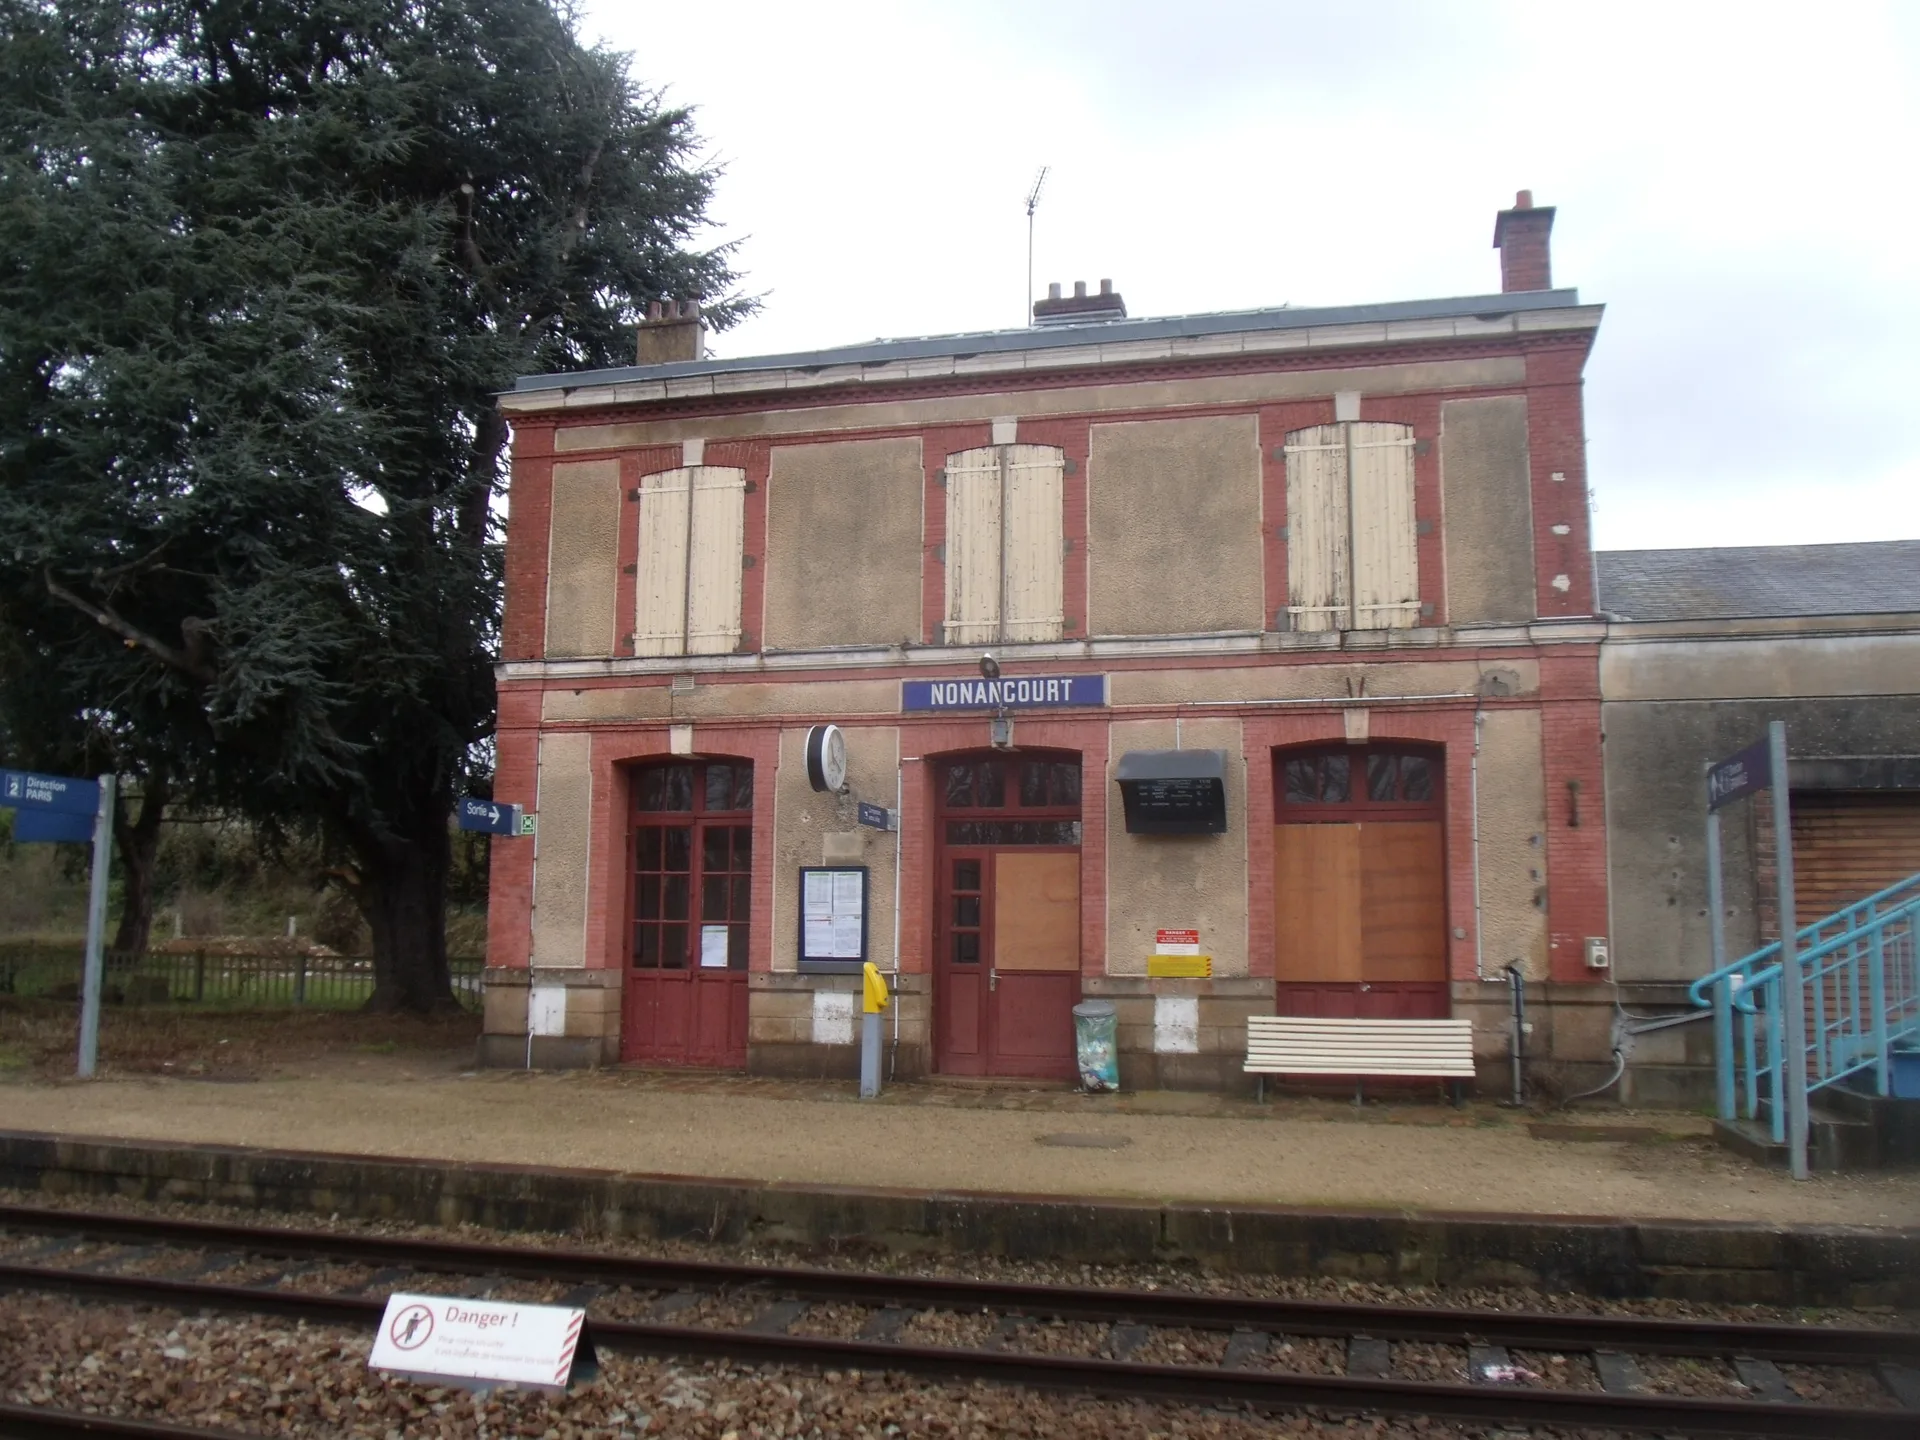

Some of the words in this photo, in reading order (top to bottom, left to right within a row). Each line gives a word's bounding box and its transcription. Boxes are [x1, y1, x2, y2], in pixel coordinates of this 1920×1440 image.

[931, 679, 1073, 705] NONANCOURT
[10, 782, 18, 796] 2
[27, 776, 66, 793] Direction
[26, 788, 53, 802] PARIS
[467, 802, 487, 816] Sortie
[445, 1306, 508, 1330] Danger
[512, 1312, 519, 1328] !
